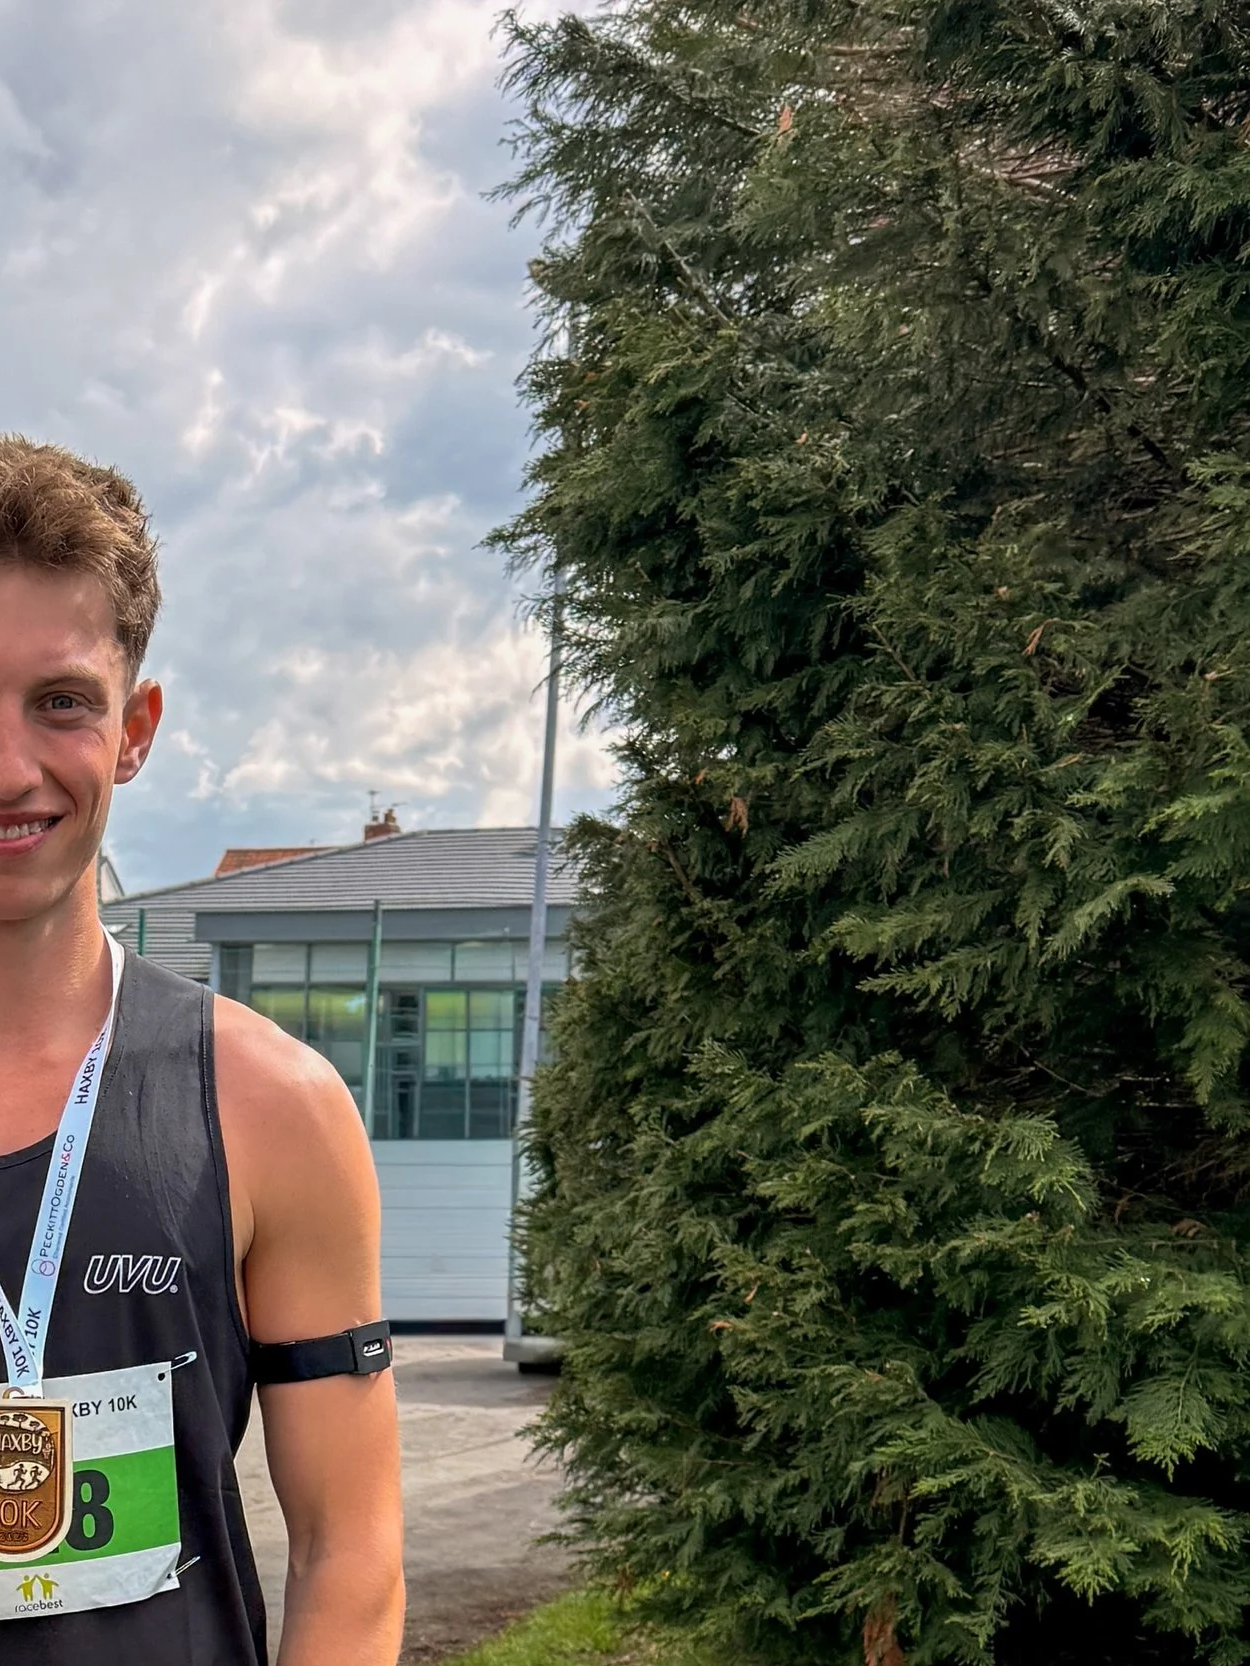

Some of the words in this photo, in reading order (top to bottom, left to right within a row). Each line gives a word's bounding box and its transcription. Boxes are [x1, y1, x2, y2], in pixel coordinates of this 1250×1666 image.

[74, 1056, 97, 1105] HAXBY
[24, 1307, 42, 1339] 10K
[12, 1346, 30, 1378] 10K
[107, 1394, 138, 1413] 10K
[14, 1599, 64, 1614] racebest
